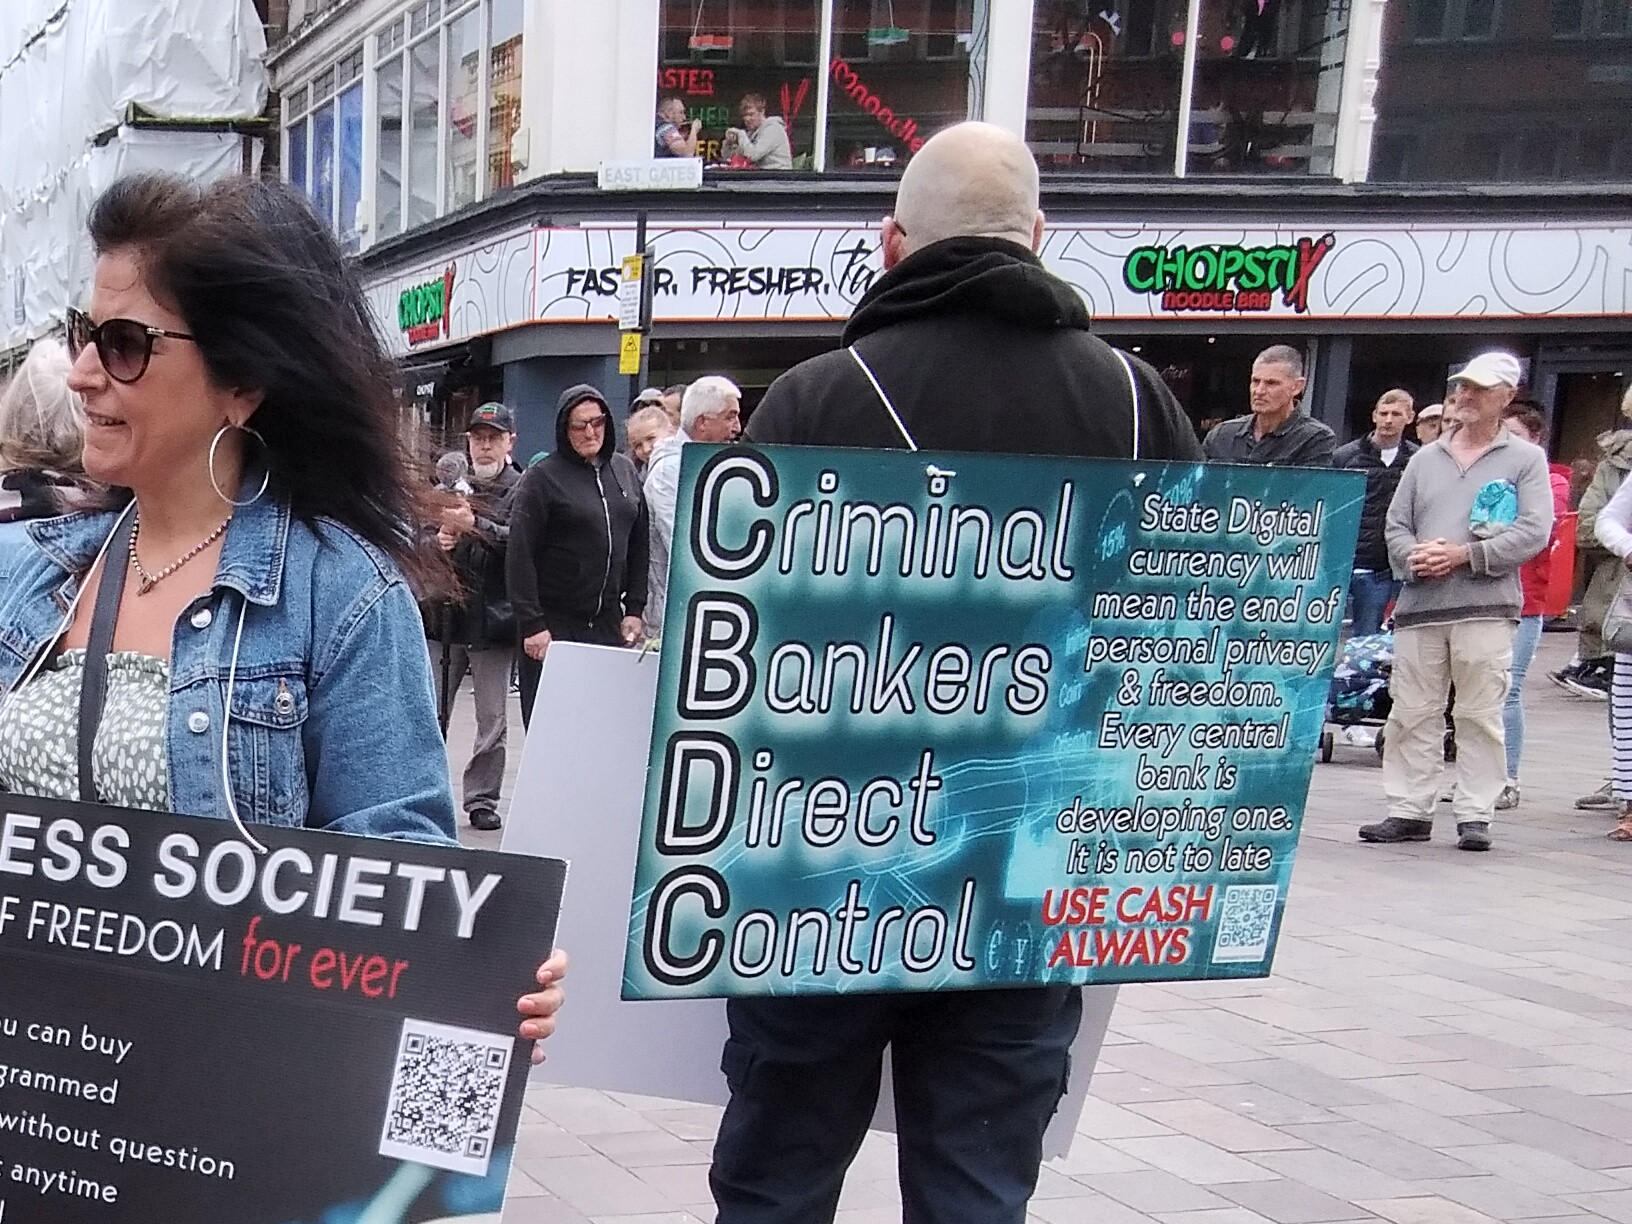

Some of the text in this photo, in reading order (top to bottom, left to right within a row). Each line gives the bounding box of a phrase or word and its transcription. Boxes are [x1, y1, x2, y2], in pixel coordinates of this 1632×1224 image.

[604, 165, 696, 183] EAST GATES
[566, 266, 677, 296] FASR.
[691, 266, 829, 296] FRESHER.
[1162, 291, 1271, 310] NOODLE BAR
[690, 447, 1075, 582] Criminal
[1139, 493, 1323, 546] State Digital
[1128, 542, 1321, 587] currency will
[1092, 583, 1341, 624] mean the end of
[677, 591, 1053, 720] Bankers
[1084, 626, 1220, 672] personal
[1222, 631, 1329, 675] privacy
[1118, 668, 1282, 708] & freedom.
[1098, 712, 1185, 757] Every
[1189, 712, 1290, 749] central
[655, 730, 942, 856] Direct
[1136, 754, 1237, 790] bank is
[1056, 797, 1294, 838] developing one.
[1066, 837, 1272, 875] It is not to late
[154, 834, 502, 939] SOCIETY
[1041, 885, 1214, 926] USE CASH
[643, 865, 977, 986] Control
[1047, 928, 1190, 968] ALWAYS
[27, 900, 225, 970] FREEDOM
[240, 916, 301, 983] for
[309, 948, 410, 999] ever
[27, 1023, 70, 1047] can
[81, 1026, 133, 1062] buy
[109, 1135, 236, 1181] question
[10, 1160, 118, 1205] anytime
